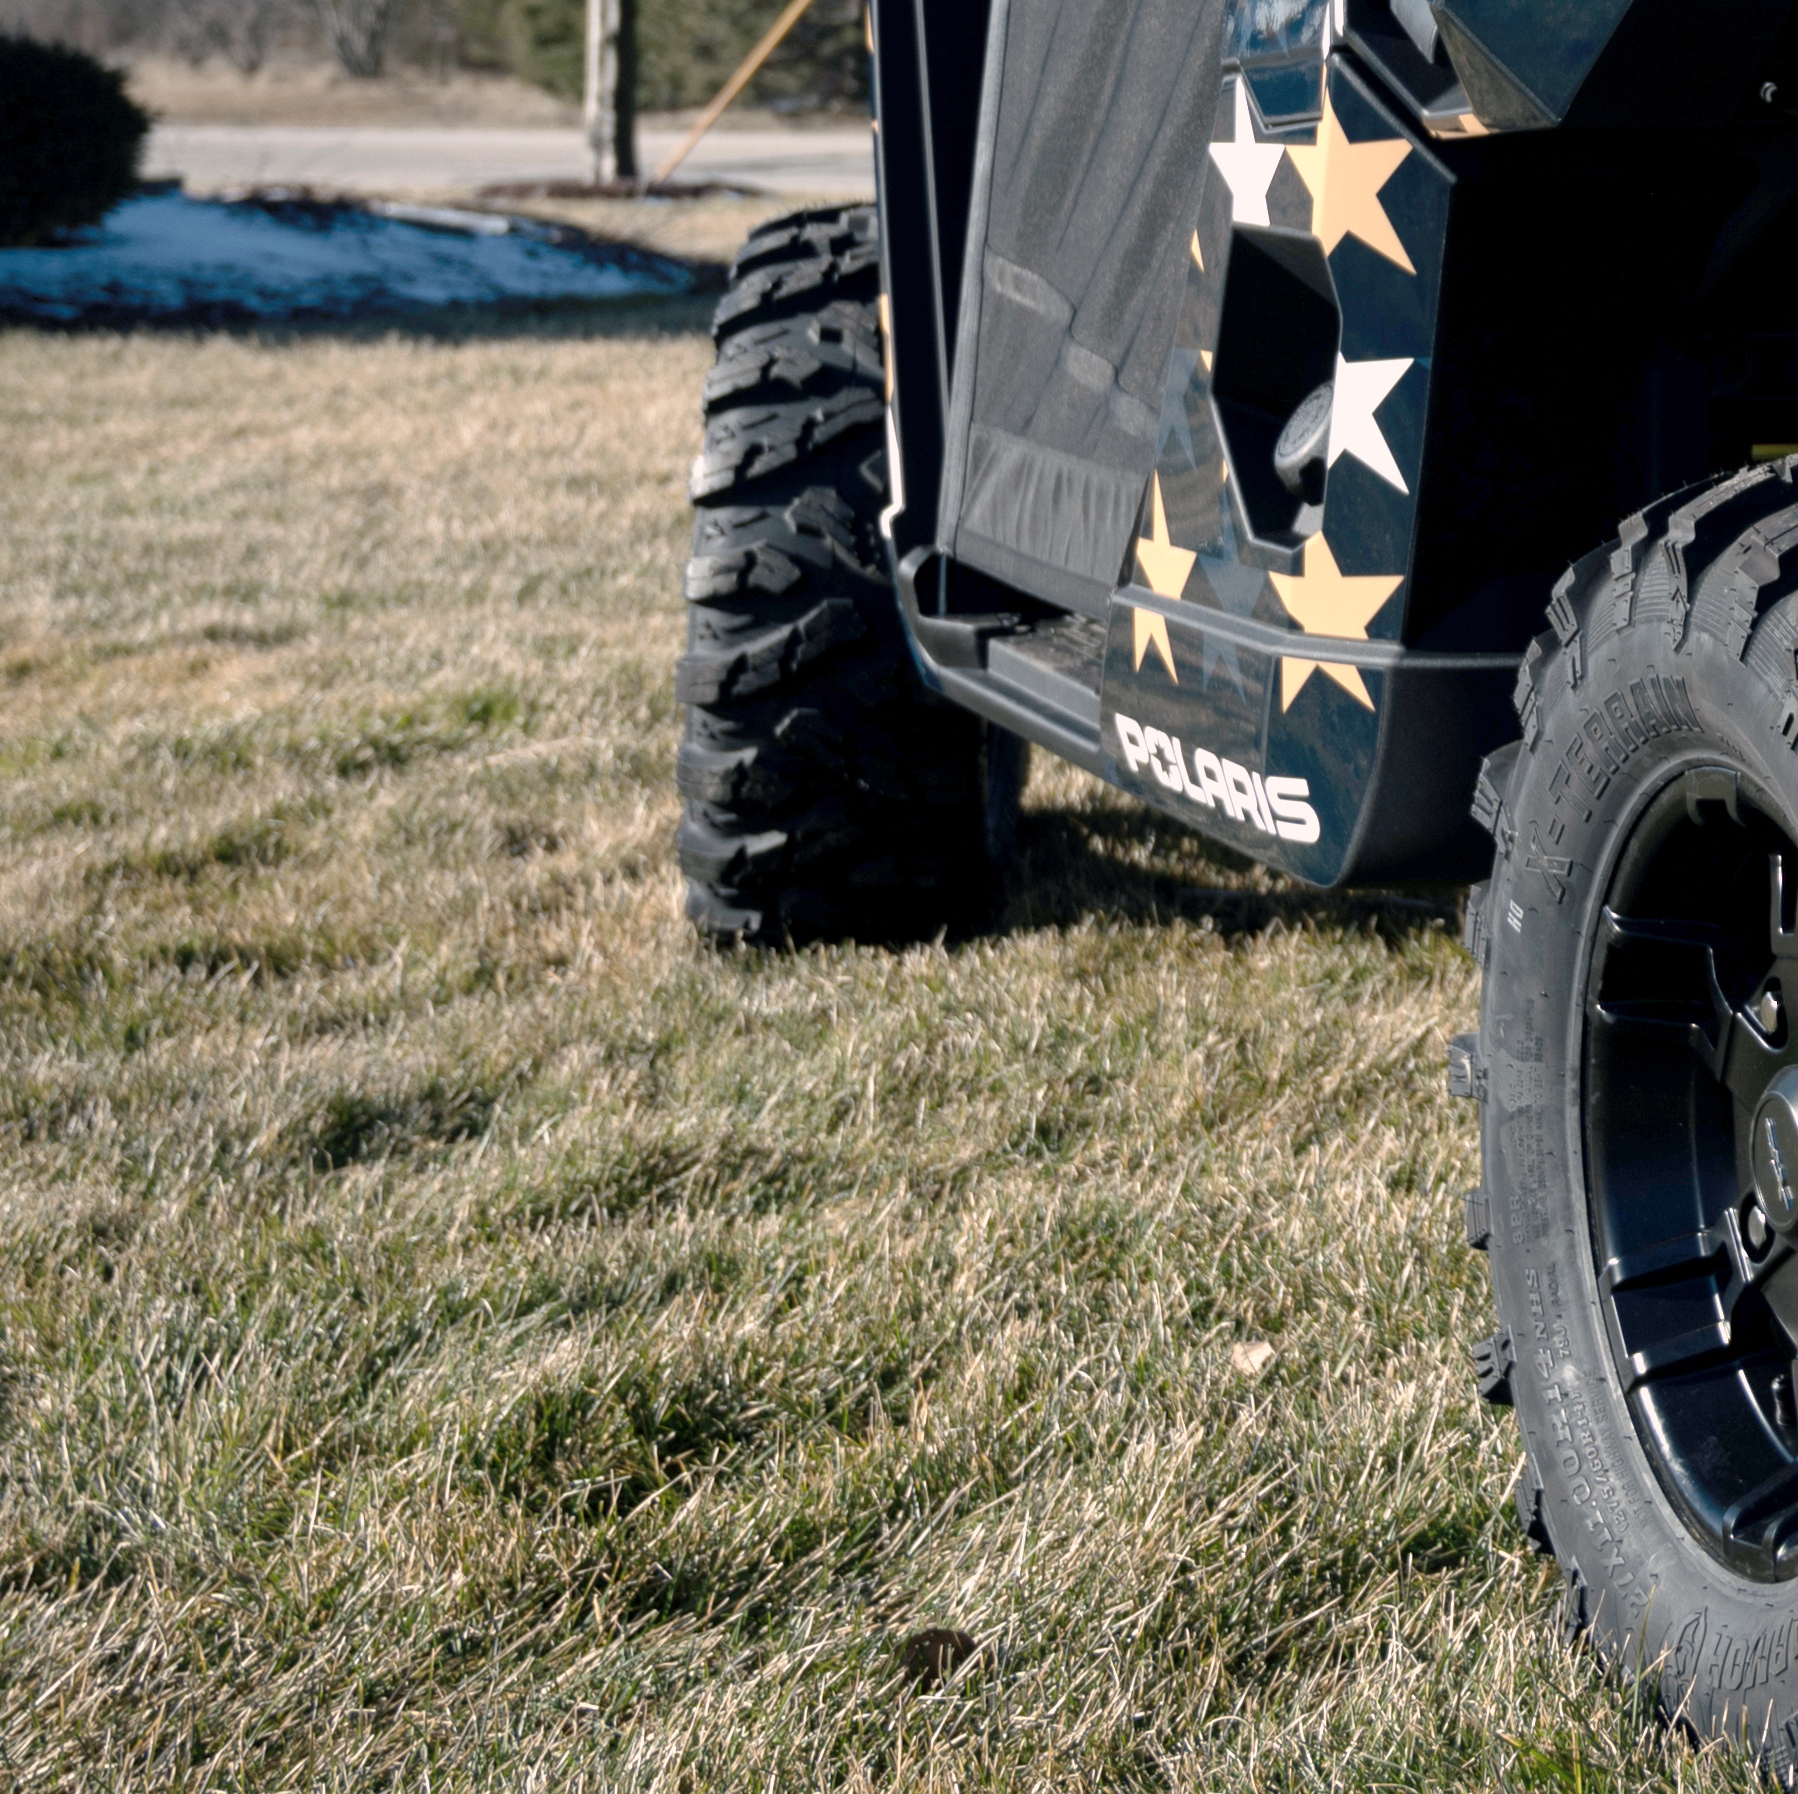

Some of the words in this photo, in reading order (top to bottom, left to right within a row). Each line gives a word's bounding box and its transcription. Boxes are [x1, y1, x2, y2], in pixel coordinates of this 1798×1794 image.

[1115, 712, 1320, 843] POLARIS
[1523, 673, 1705, 905] X-TERRAIN
[1506, 899, 1524, 934] HD
[1621, 1481, 1641, 1504] FOR
